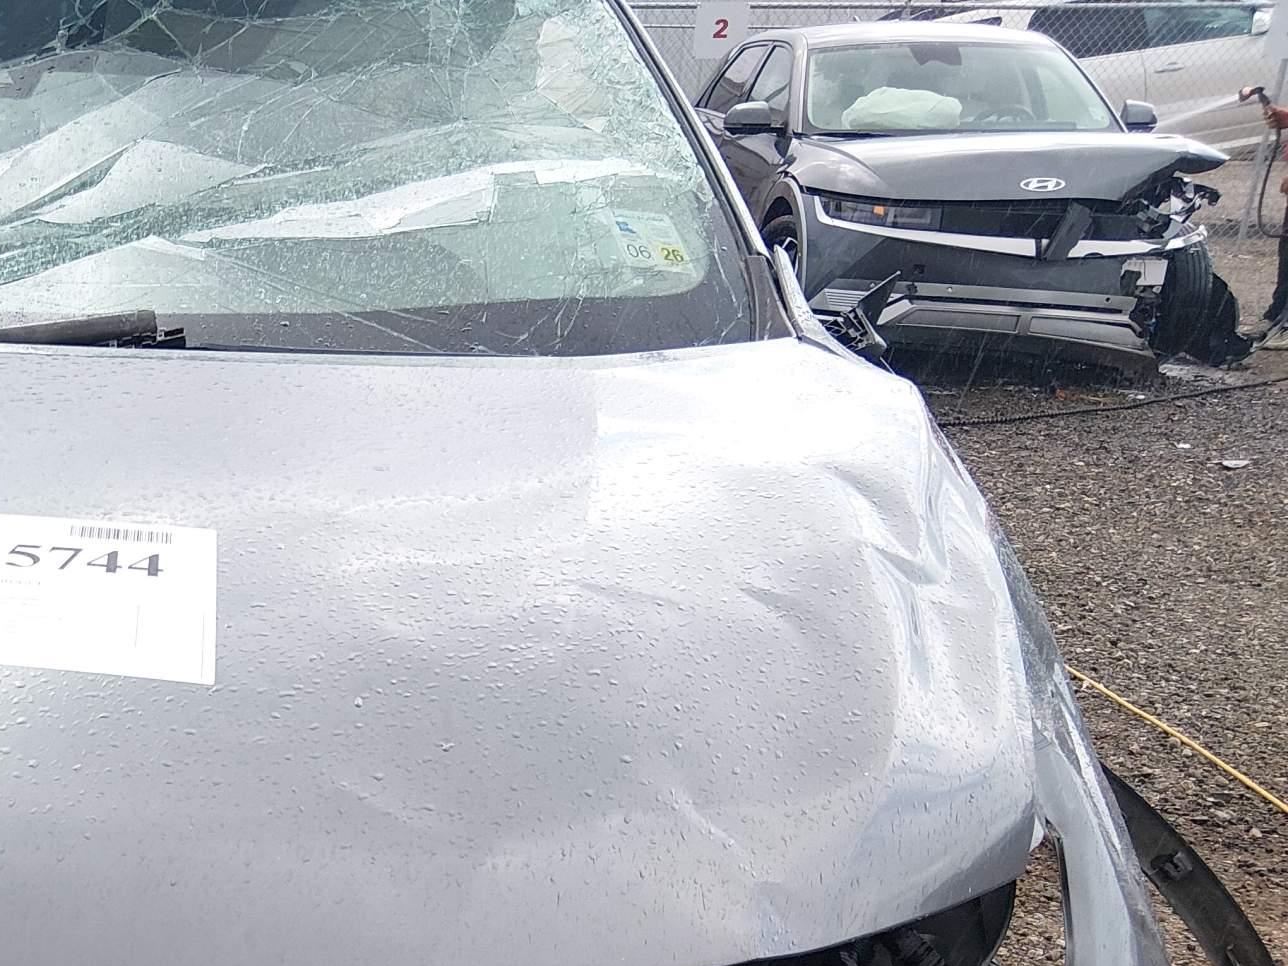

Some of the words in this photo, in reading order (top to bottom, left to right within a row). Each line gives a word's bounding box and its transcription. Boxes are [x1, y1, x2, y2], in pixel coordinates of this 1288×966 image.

[712, 18, 729, 39] 2
[626, 243, 652, 260] 06
[660, 247, 685, 263] 26
